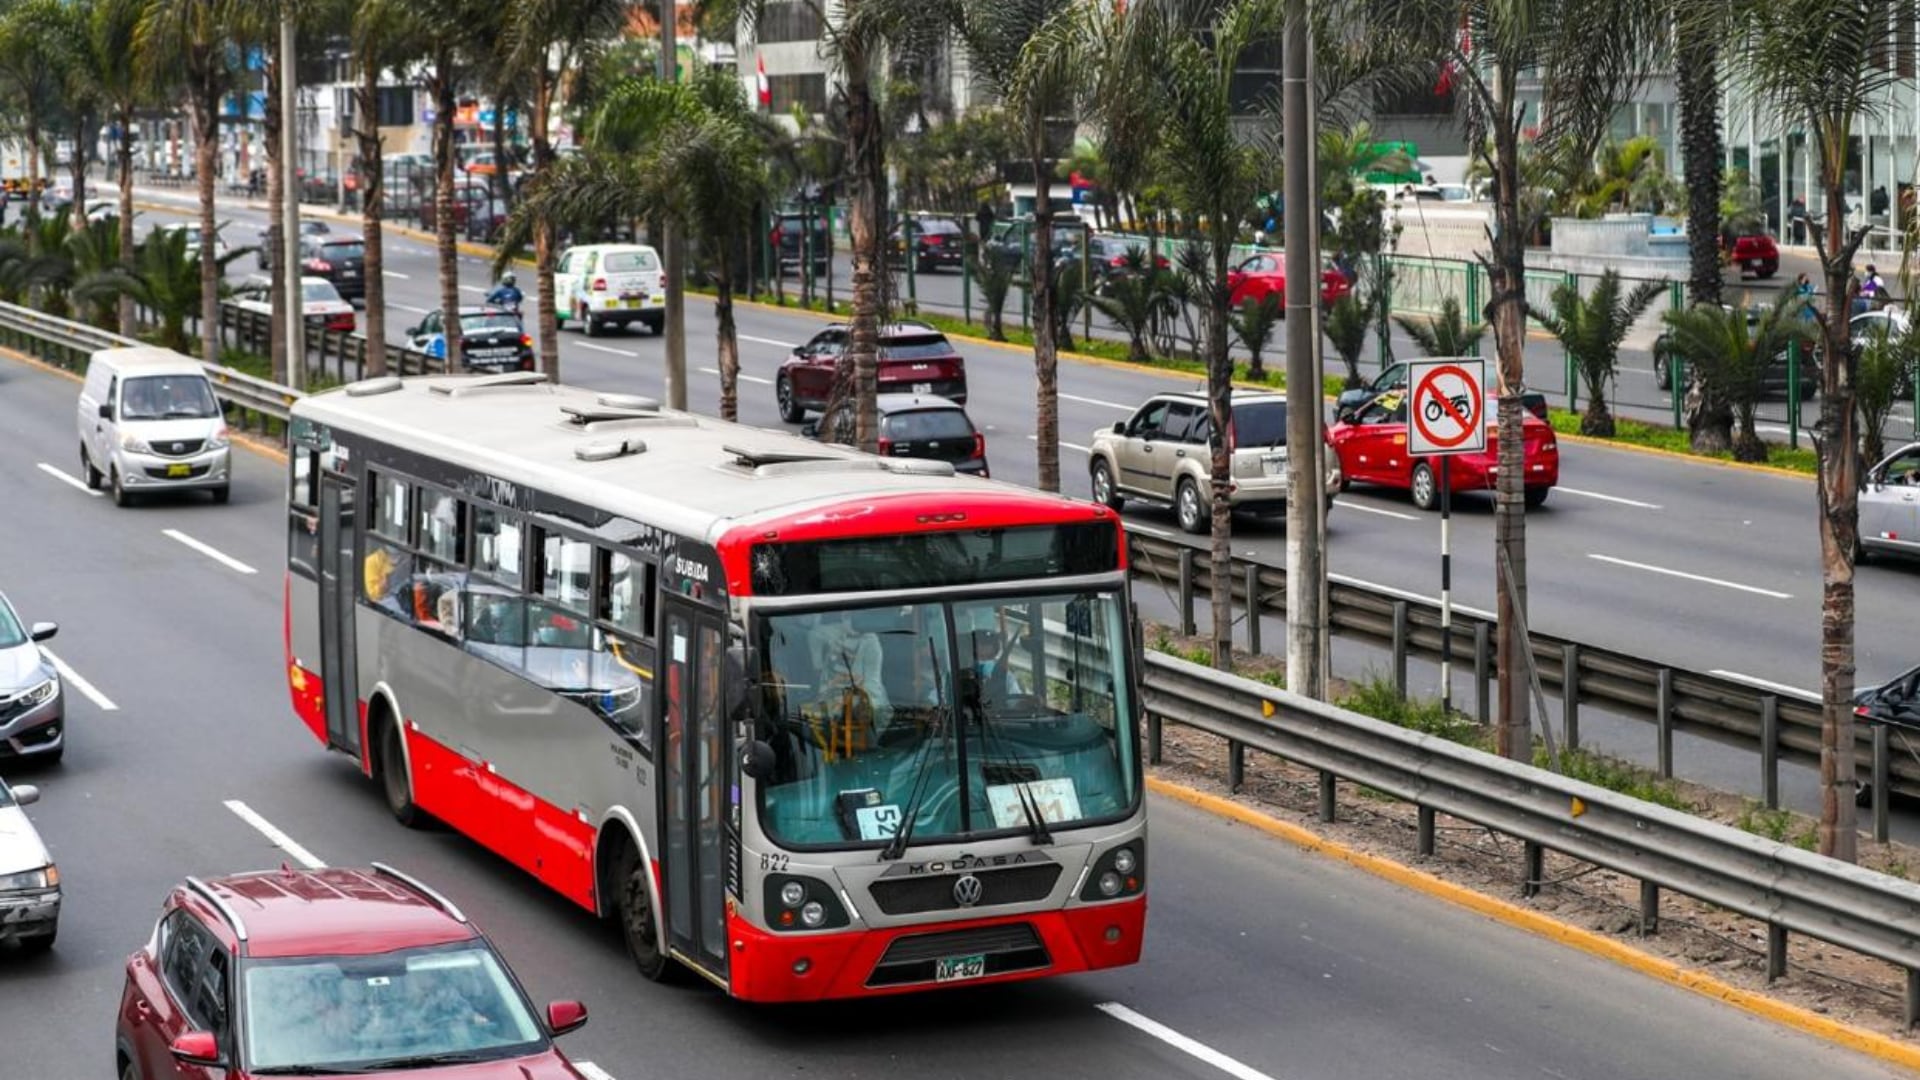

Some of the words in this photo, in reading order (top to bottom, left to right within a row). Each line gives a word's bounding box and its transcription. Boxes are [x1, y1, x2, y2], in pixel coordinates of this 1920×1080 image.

[675, 557, 709, 582] SUBIDA
[875, 809, 898, 836] 52
[760, 852, 790, 871] 822
[909, 853, 1027, 874] MODASA
